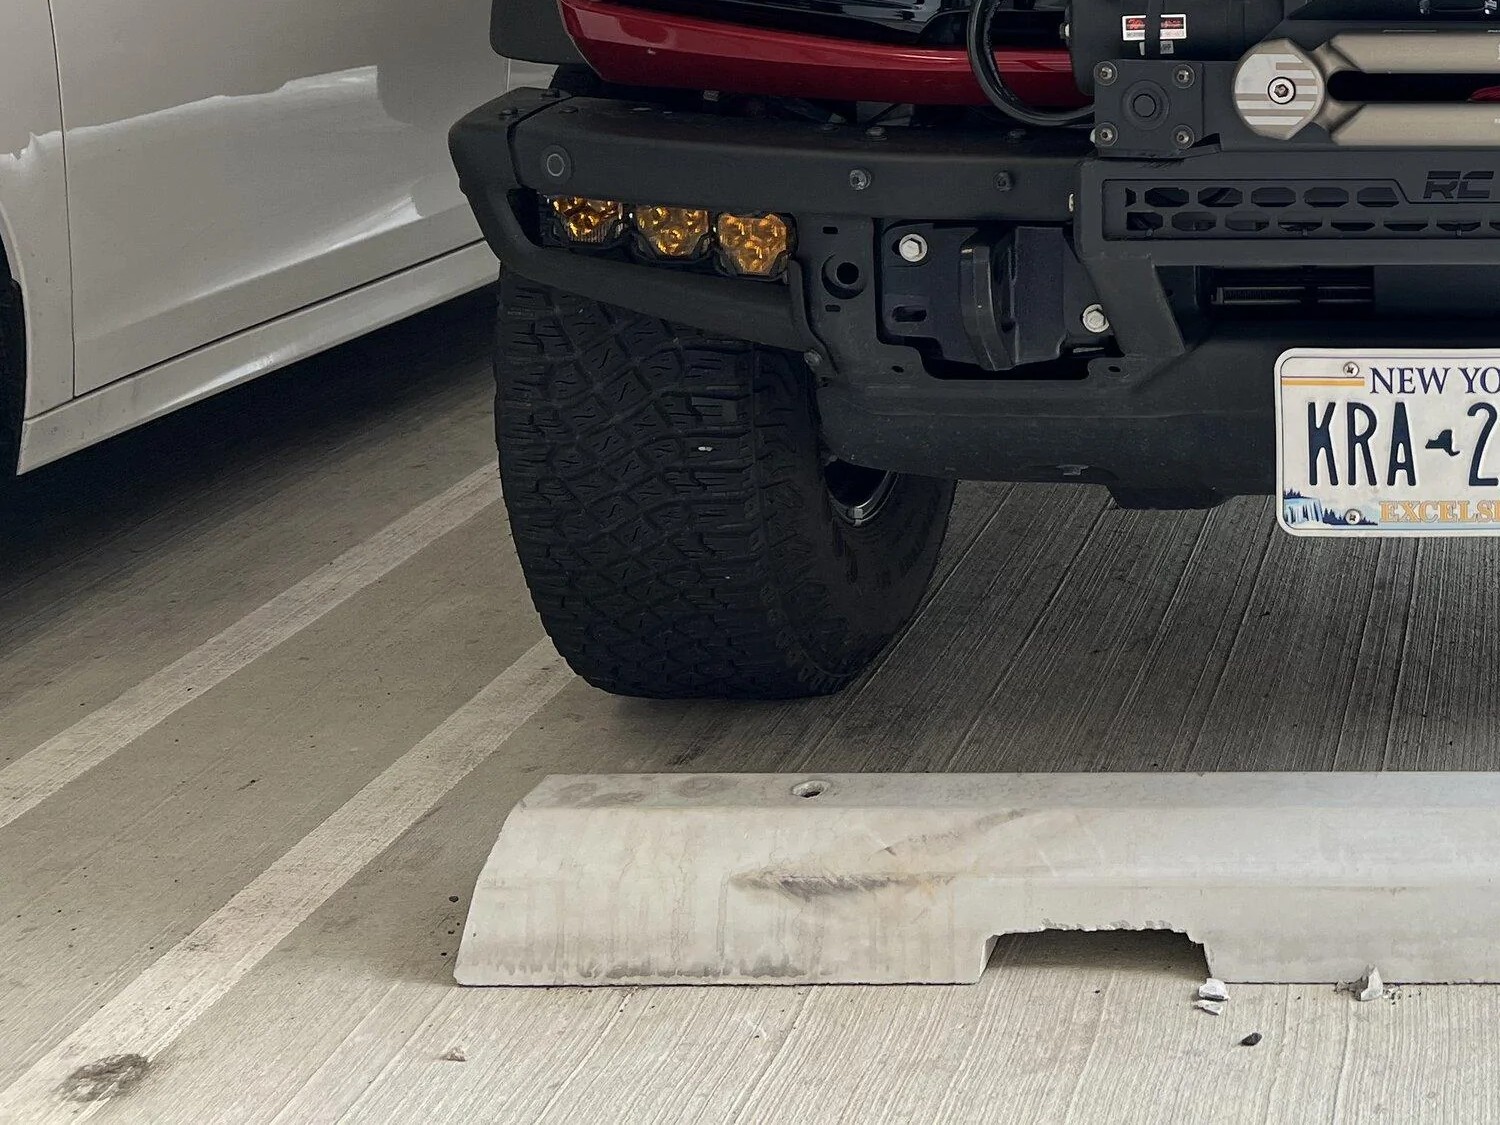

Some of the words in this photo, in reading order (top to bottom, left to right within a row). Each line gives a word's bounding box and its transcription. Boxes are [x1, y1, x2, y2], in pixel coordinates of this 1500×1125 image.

[1423, 170, 1494, 199] RC
[1369, 366, 1451, 394] NEW
[1307, 401, 1417, 487] KRA
